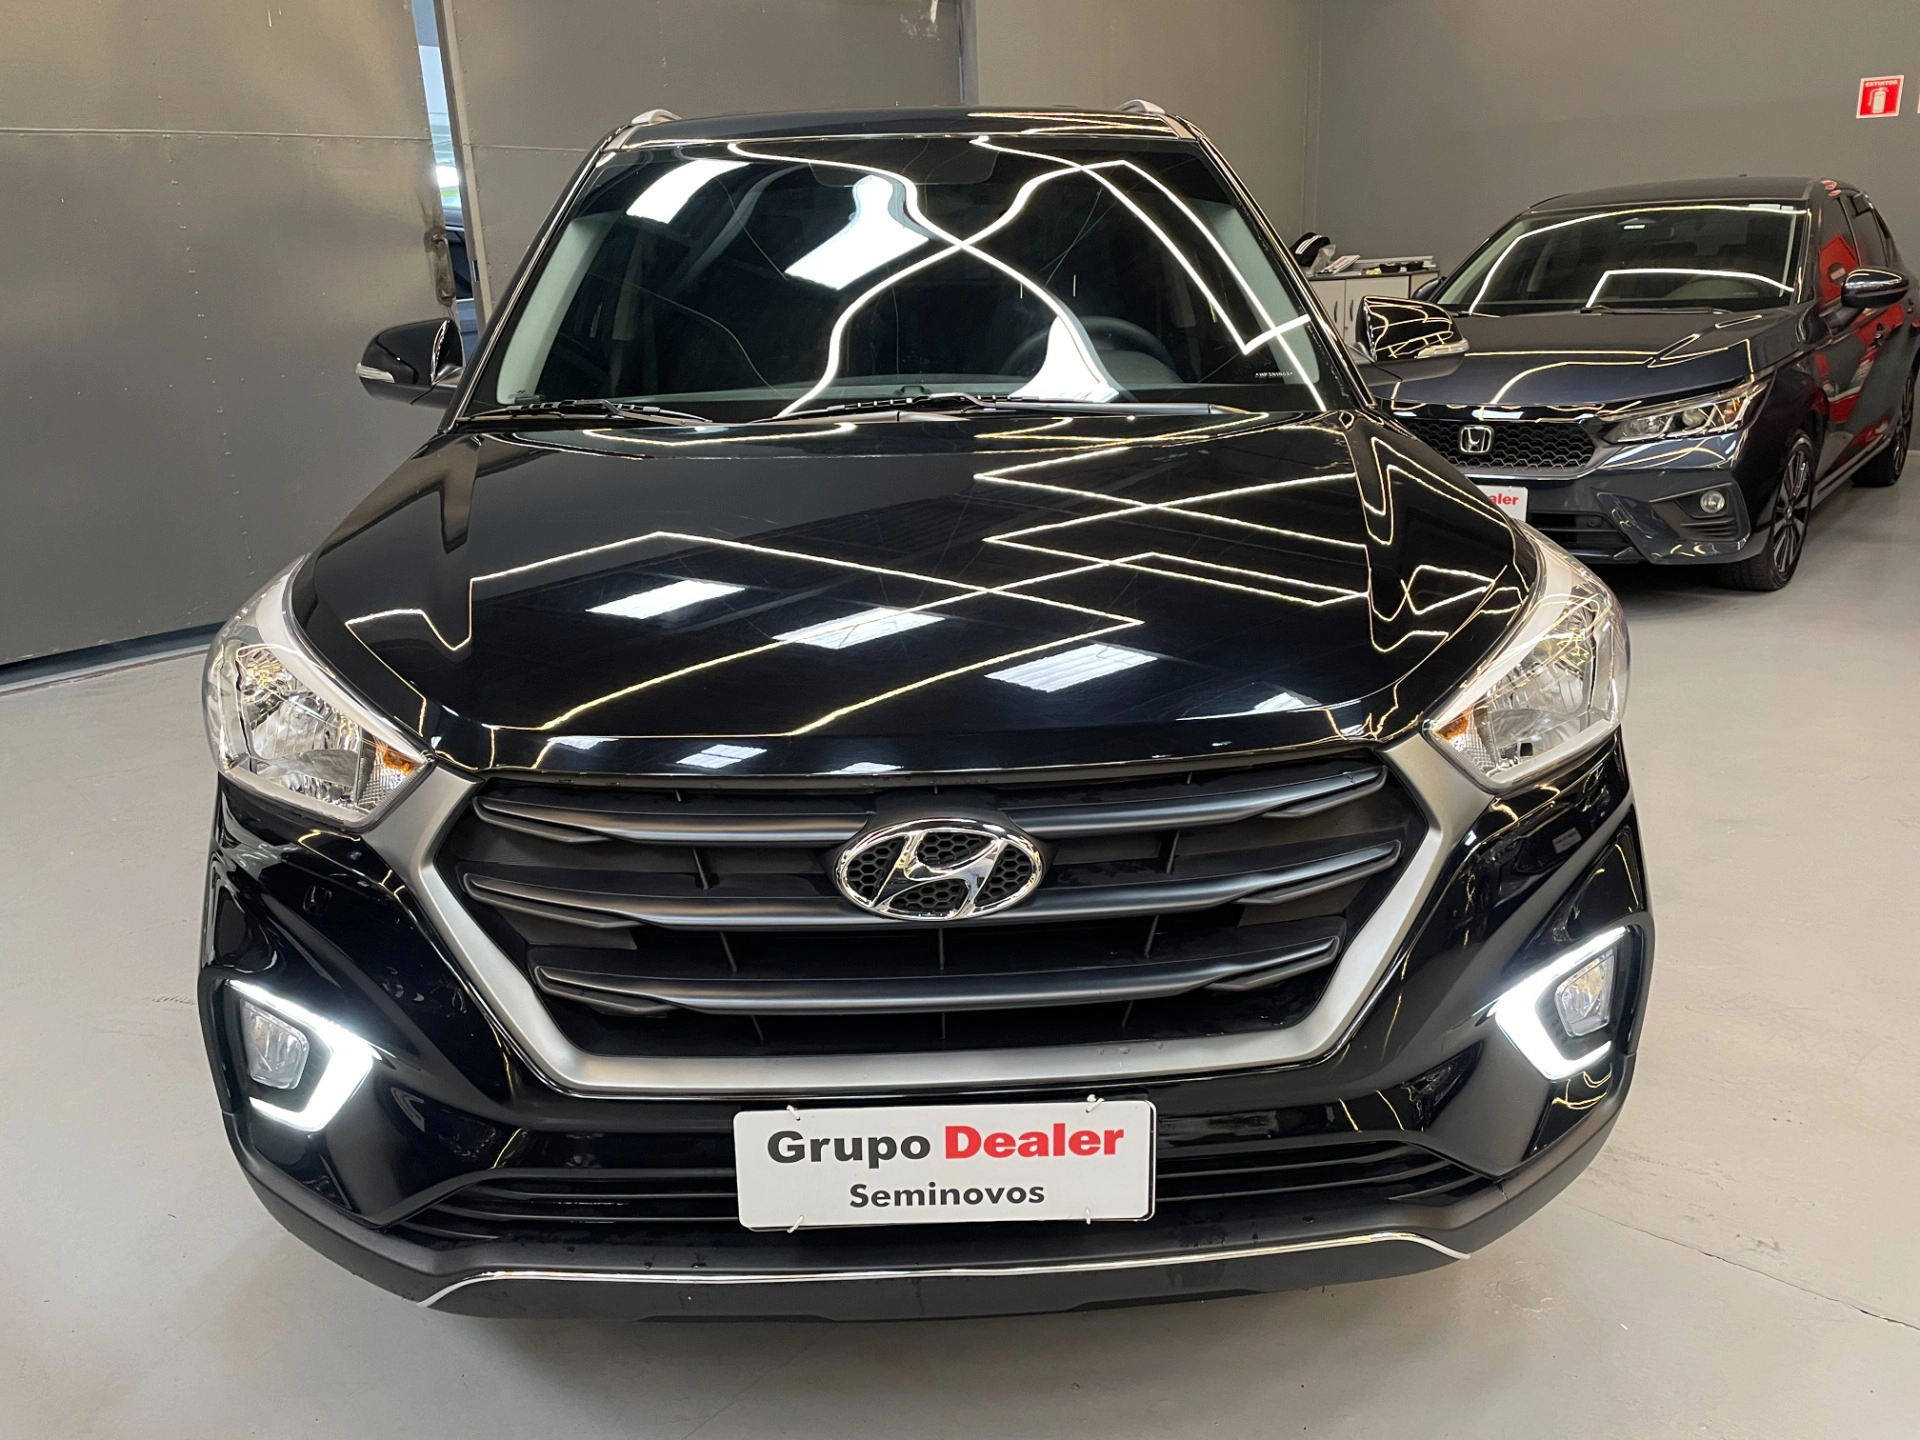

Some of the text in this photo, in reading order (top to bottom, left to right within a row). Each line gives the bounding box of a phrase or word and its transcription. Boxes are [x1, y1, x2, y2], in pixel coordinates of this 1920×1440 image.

[1488, 493, 1519, 505] aler
[767, 1123, 1125, 1169] Grupo Dealer
[849, 1181, 1045, 1208] Seminovos
